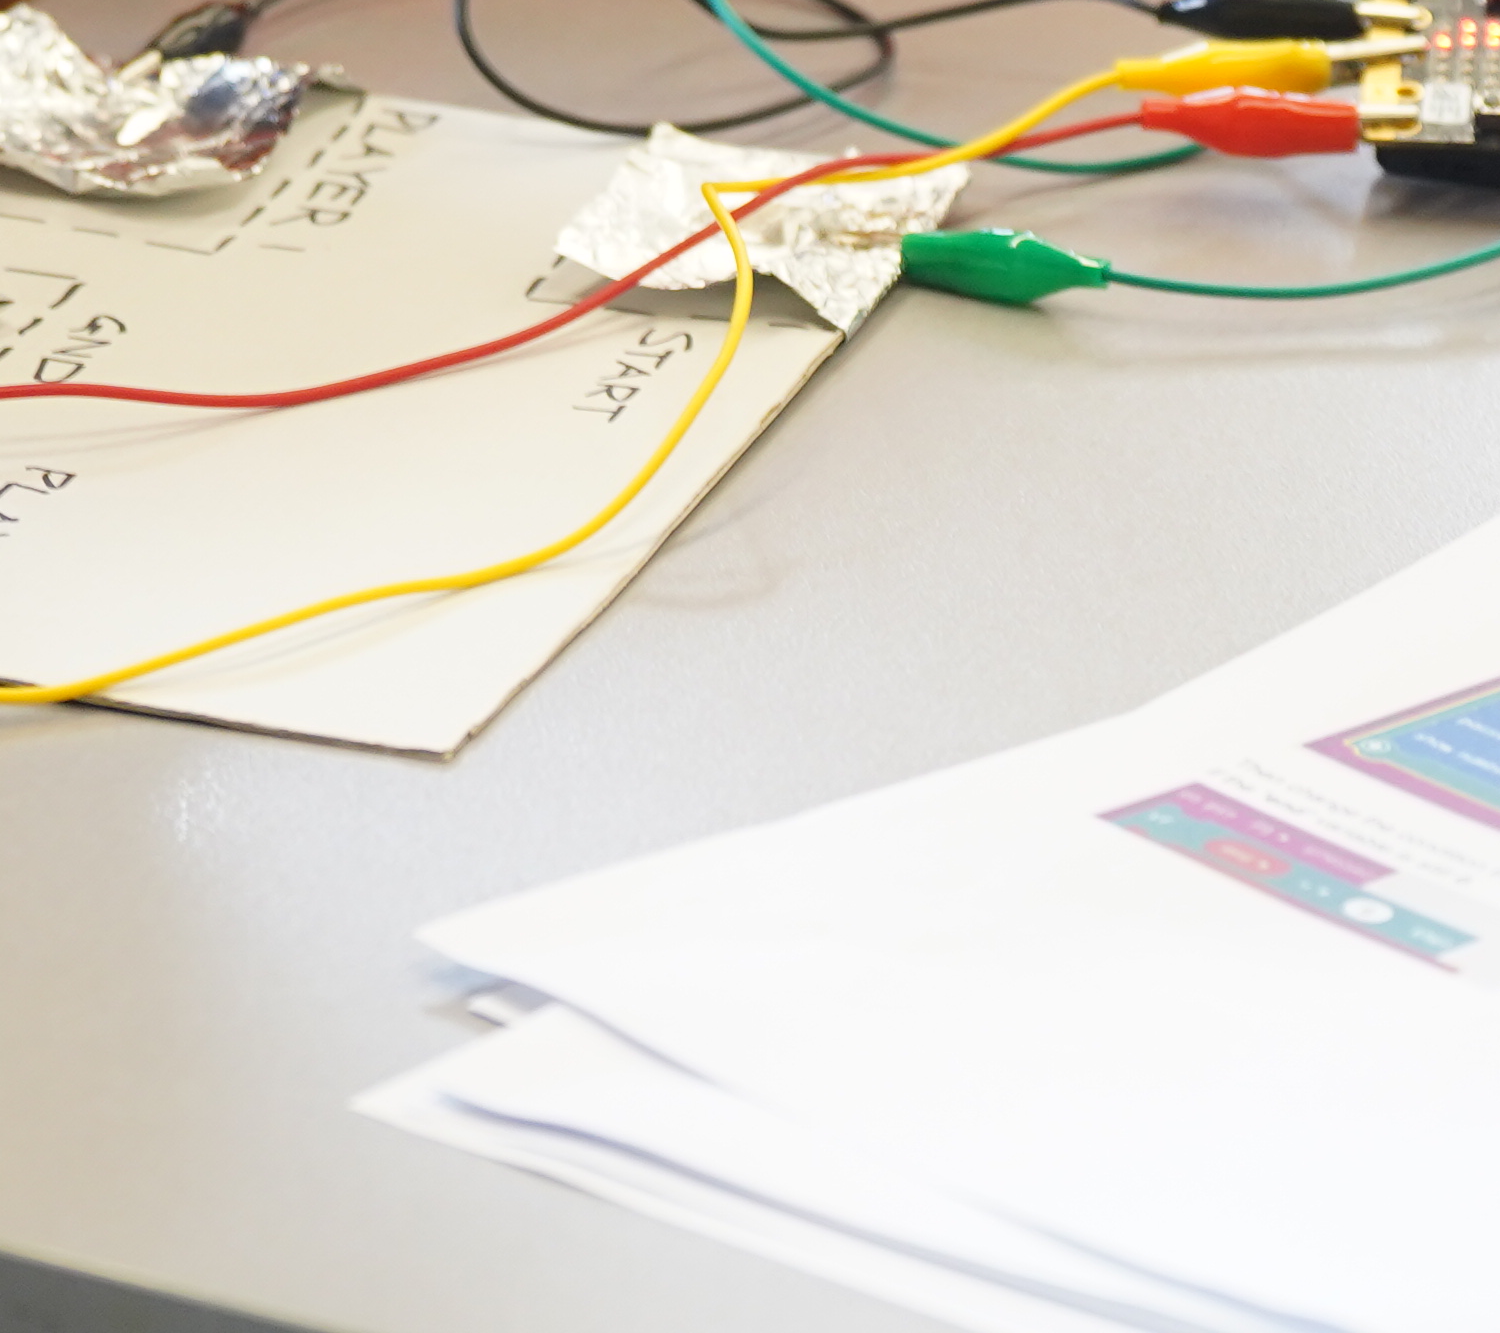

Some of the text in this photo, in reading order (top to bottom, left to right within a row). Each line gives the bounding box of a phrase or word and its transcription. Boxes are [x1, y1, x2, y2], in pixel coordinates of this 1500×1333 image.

[269, 107, 441, 226] PLAYER
[33, 314, 128, 383] GND
[571, 328, 694, 424] START
